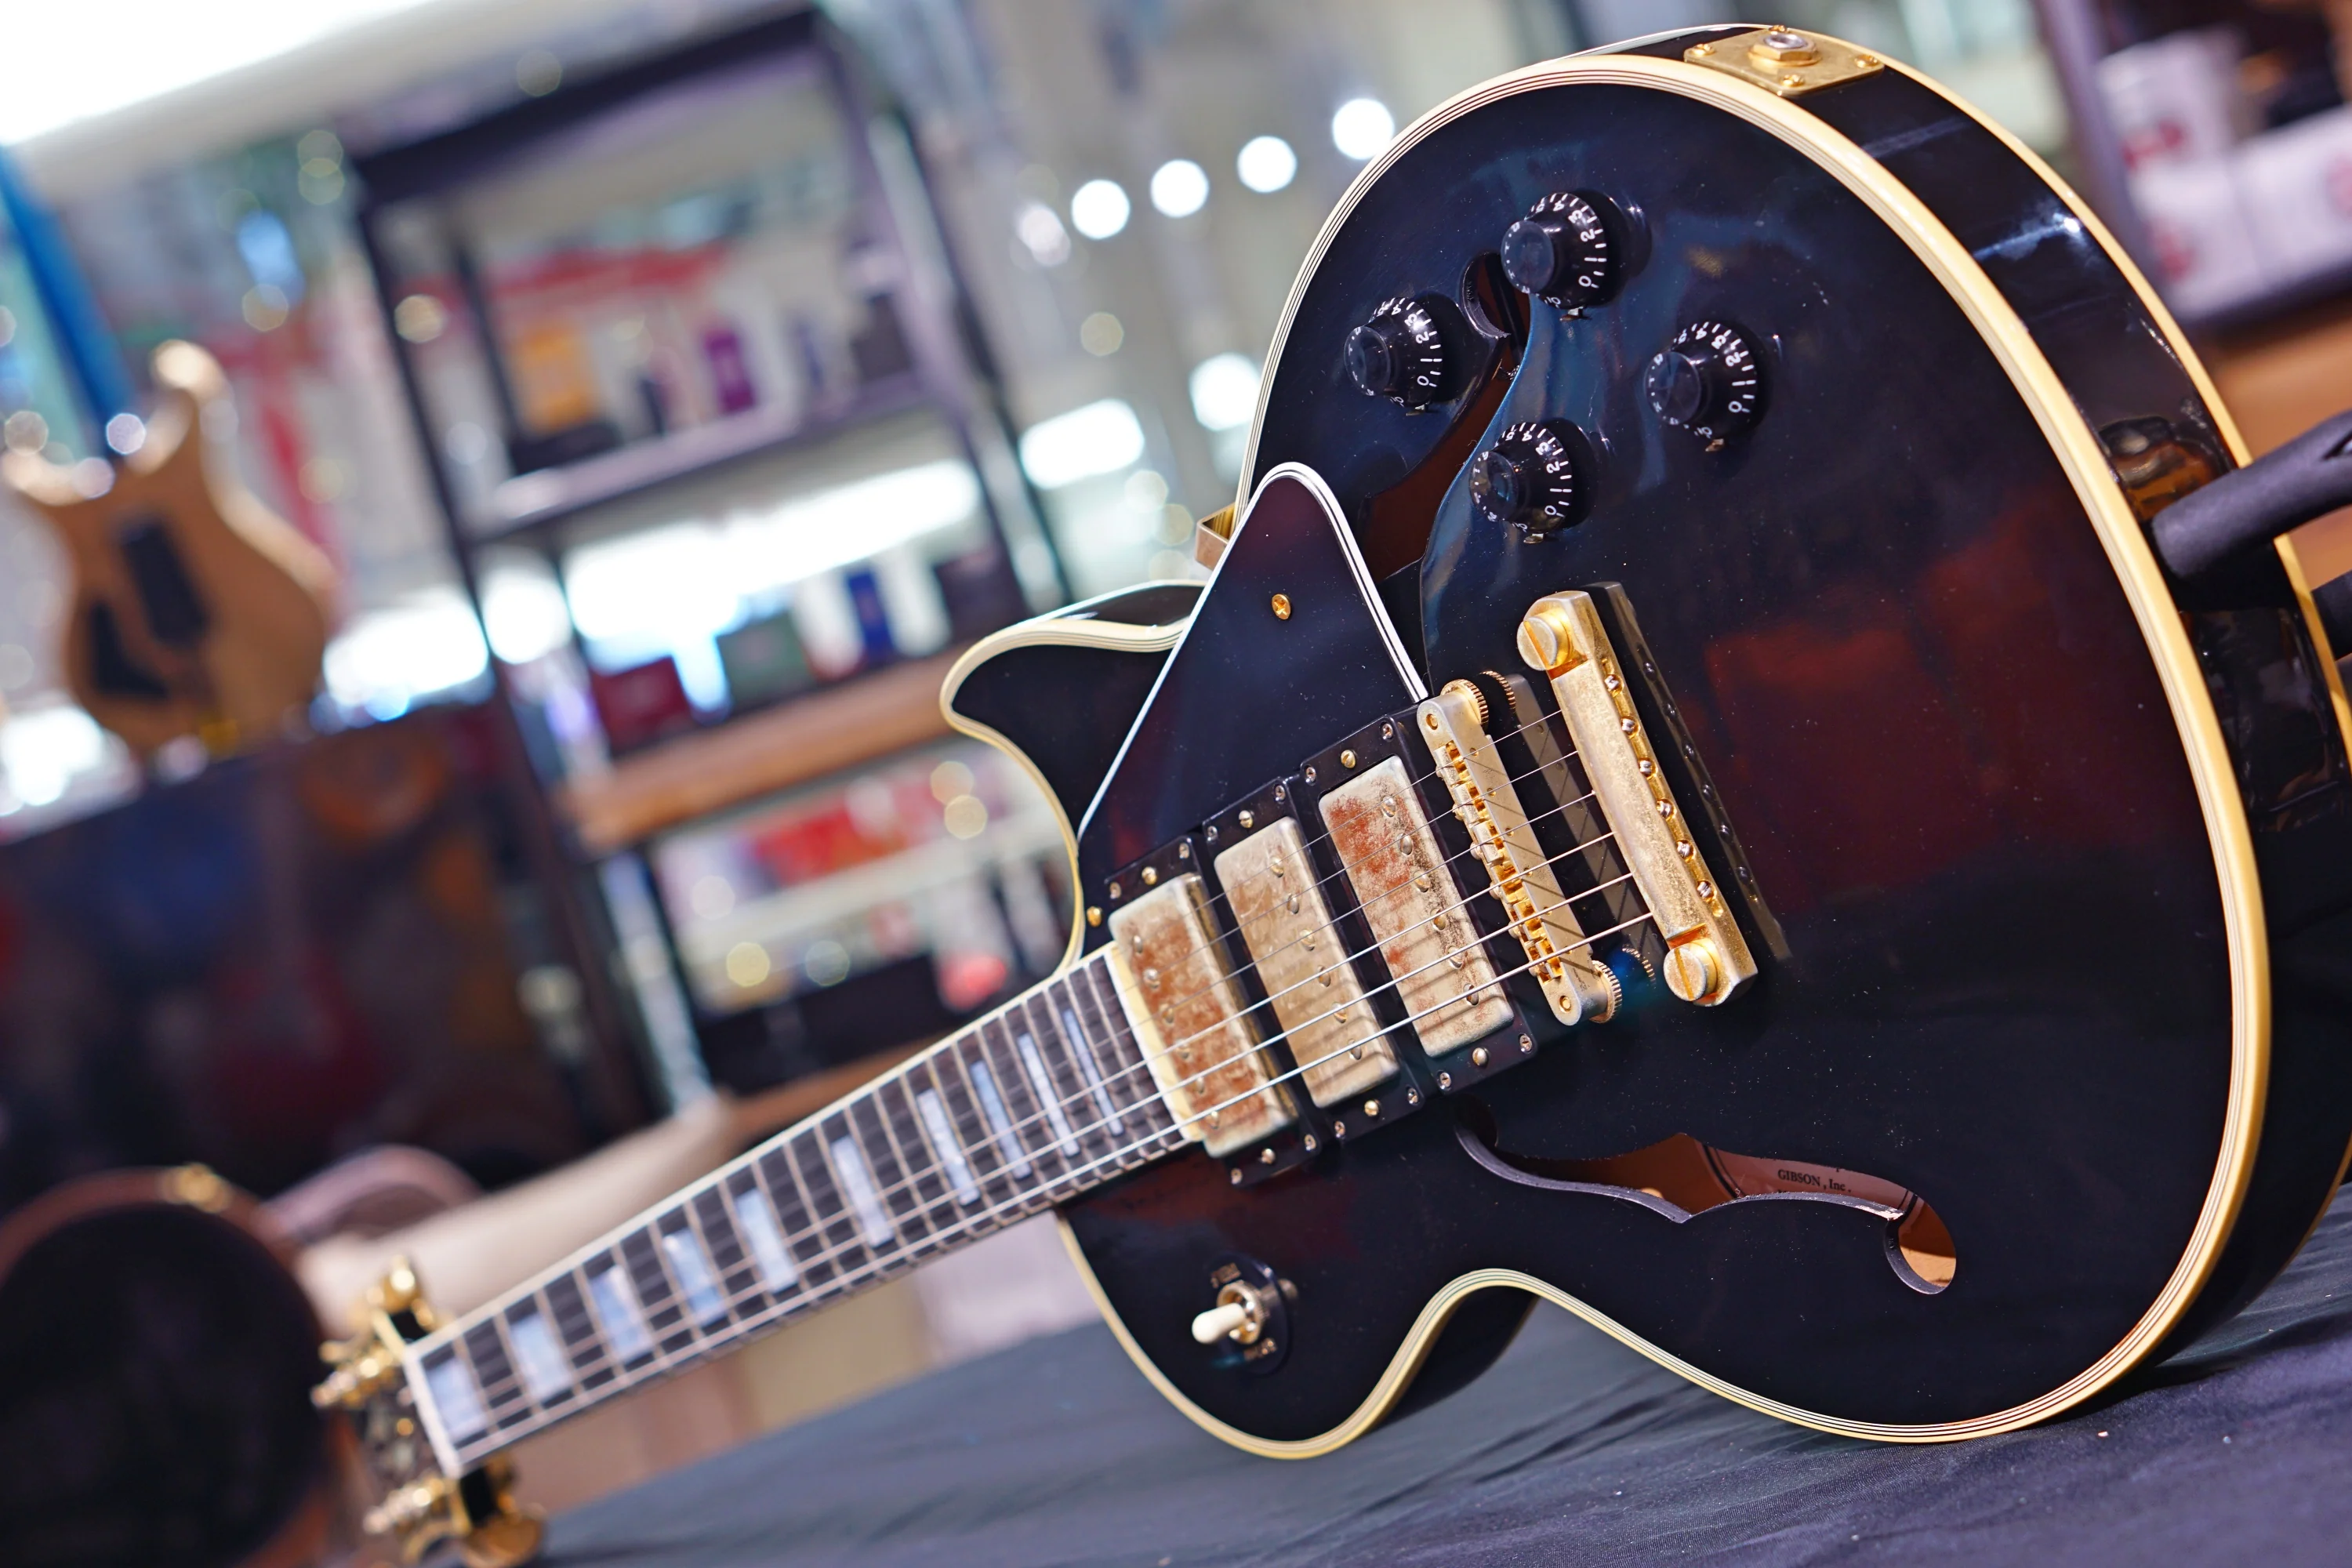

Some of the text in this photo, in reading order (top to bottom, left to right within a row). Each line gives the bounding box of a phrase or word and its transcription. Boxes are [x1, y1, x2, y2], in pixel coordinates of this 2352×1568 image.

[1580, 229, 1595, 241] 2
[1415, 331, 1429, 343] 2
[1726, 352, 1741, 367] 2
[1546, 461, 1560, 474] 2
